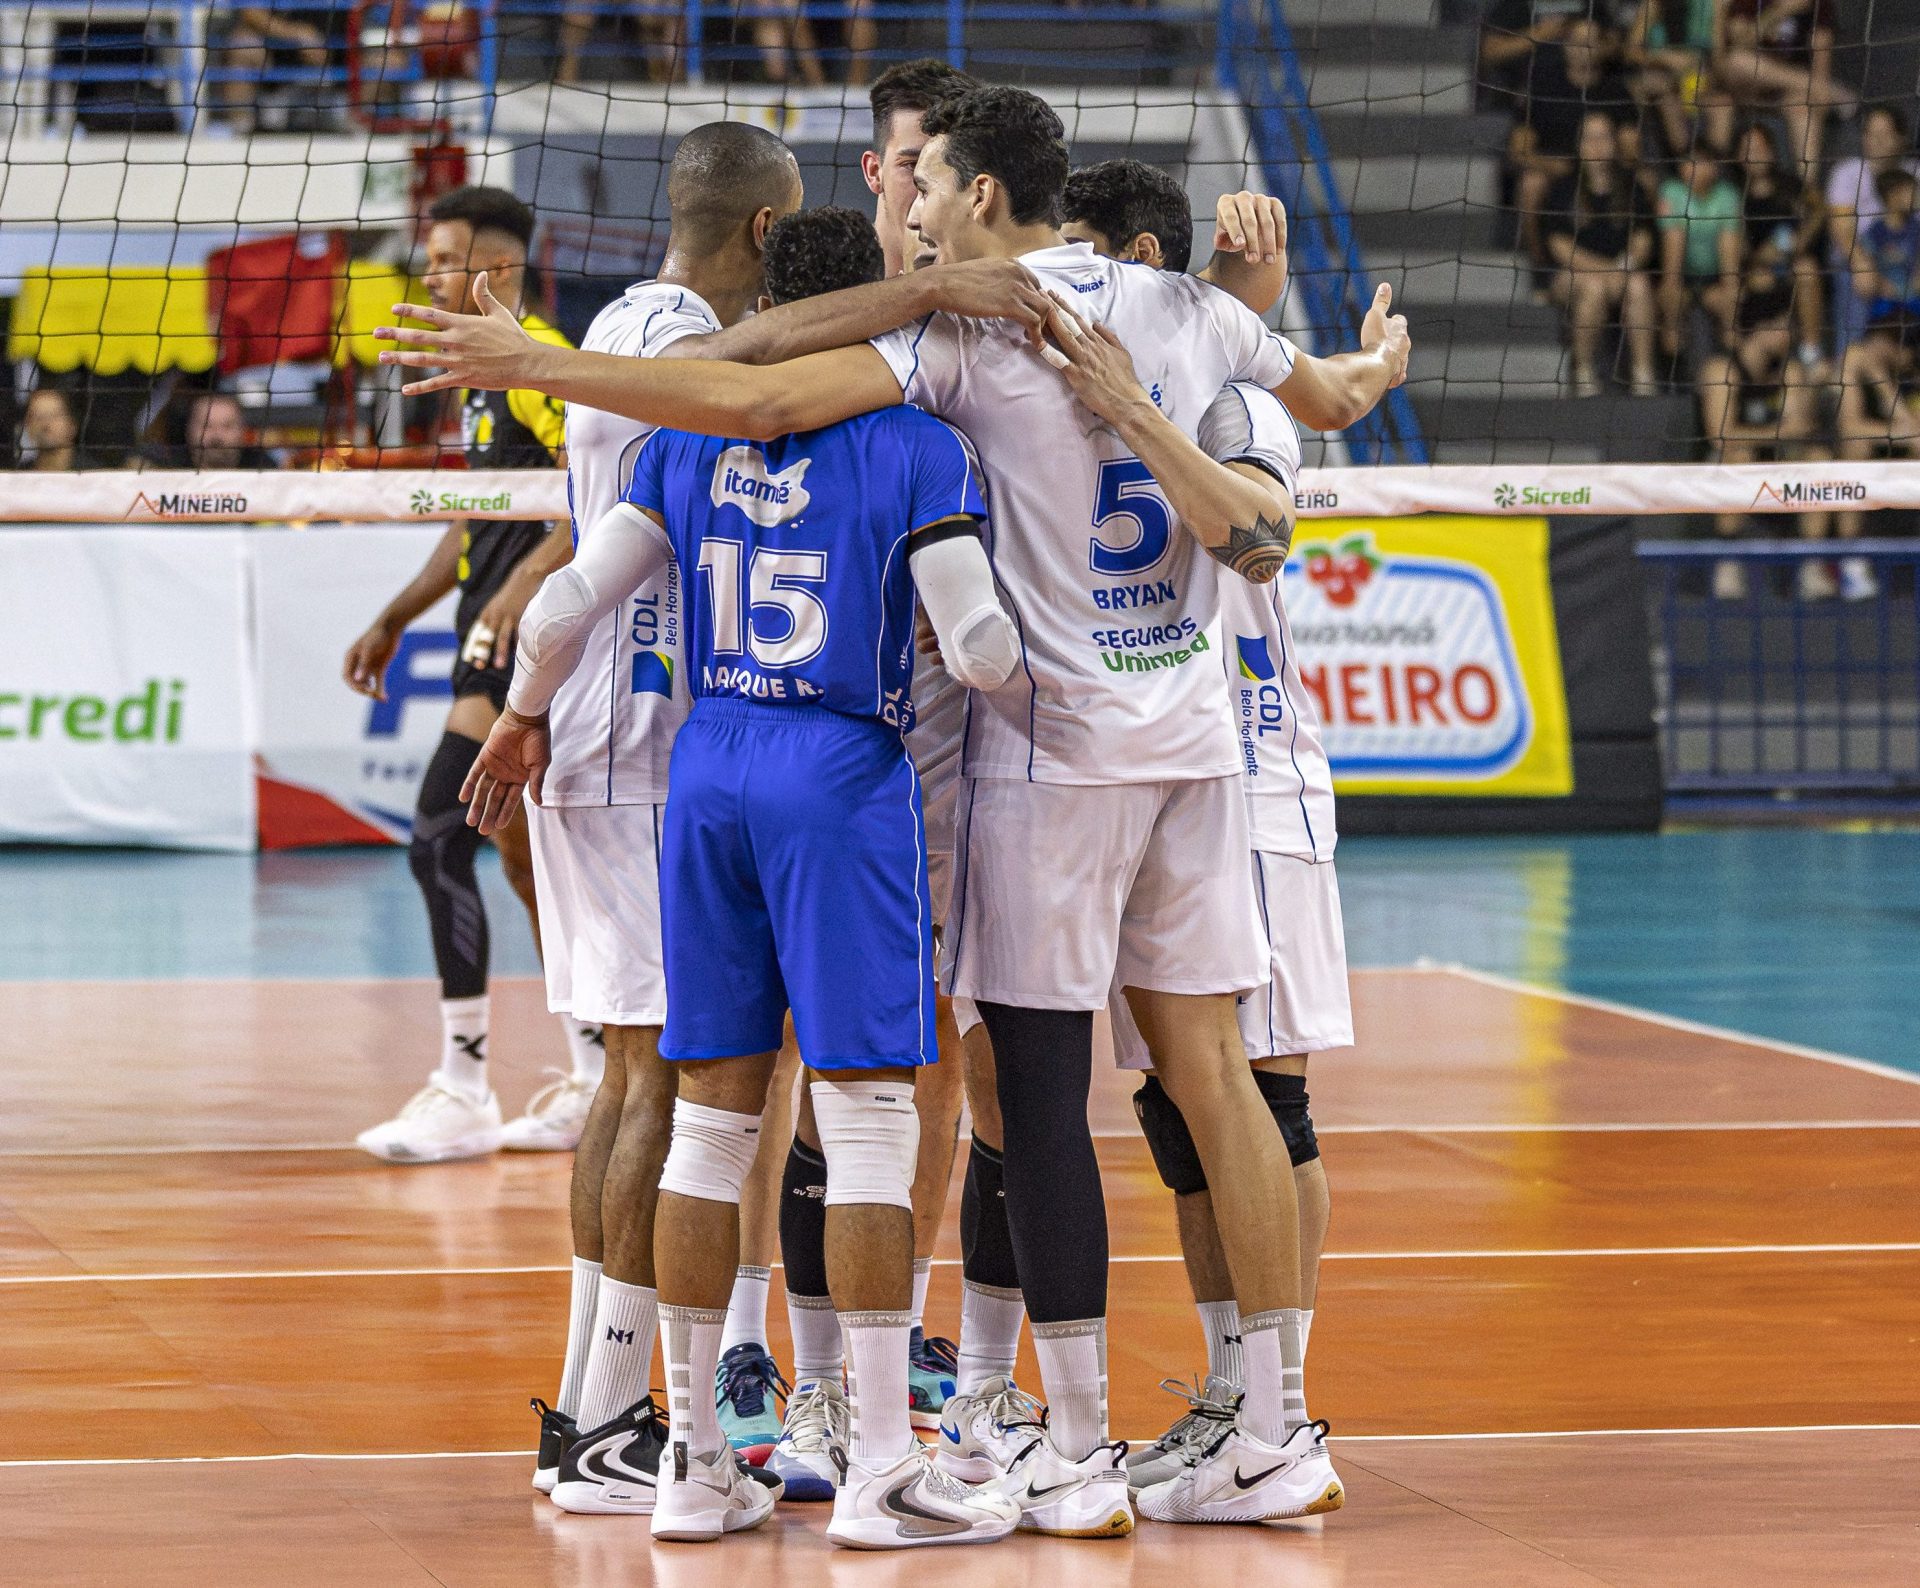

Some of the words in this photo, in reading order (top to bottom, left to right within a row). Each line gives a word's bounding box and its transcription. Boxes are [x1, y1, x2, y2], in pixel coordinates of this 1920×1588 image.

[439, 491, 512, 511] Sicredi
[724, 467, 790, 505] itamé
[1294, 493, 1338, 509] EIRO
[1521, 485, 1592, 505] Sicredi
[1783, 483, 1866, 502] MINEIRO
[160, 494, 248, 514] MINEIRO
[1090, 457, 1172, 576] 5
[664, 555, 678, 614] Horizon
[1092, 579, 1177, 610] BRYAN
[632, 593, 659, 646] CDL
[697, 537, 828, 669] 15
[664, 617, 677, 646] Belo
[1092, 616, 1198, 649] SEGUROS
[1101, 630, 1211, 673] Unimed
[0, 678, 187, 745] credi
[882, 688, 903, 728] DL
[1240, 689, 1255, 717] Belo
[1258, 685, 1283, 738] CDL
[1299, 661, 1499, 727] NEIRO
[1241, 718, 1260, 777] Horizonte
[606, 1326, 635, 1346] N1
[633, 1405, 651, 1422] NIKE
